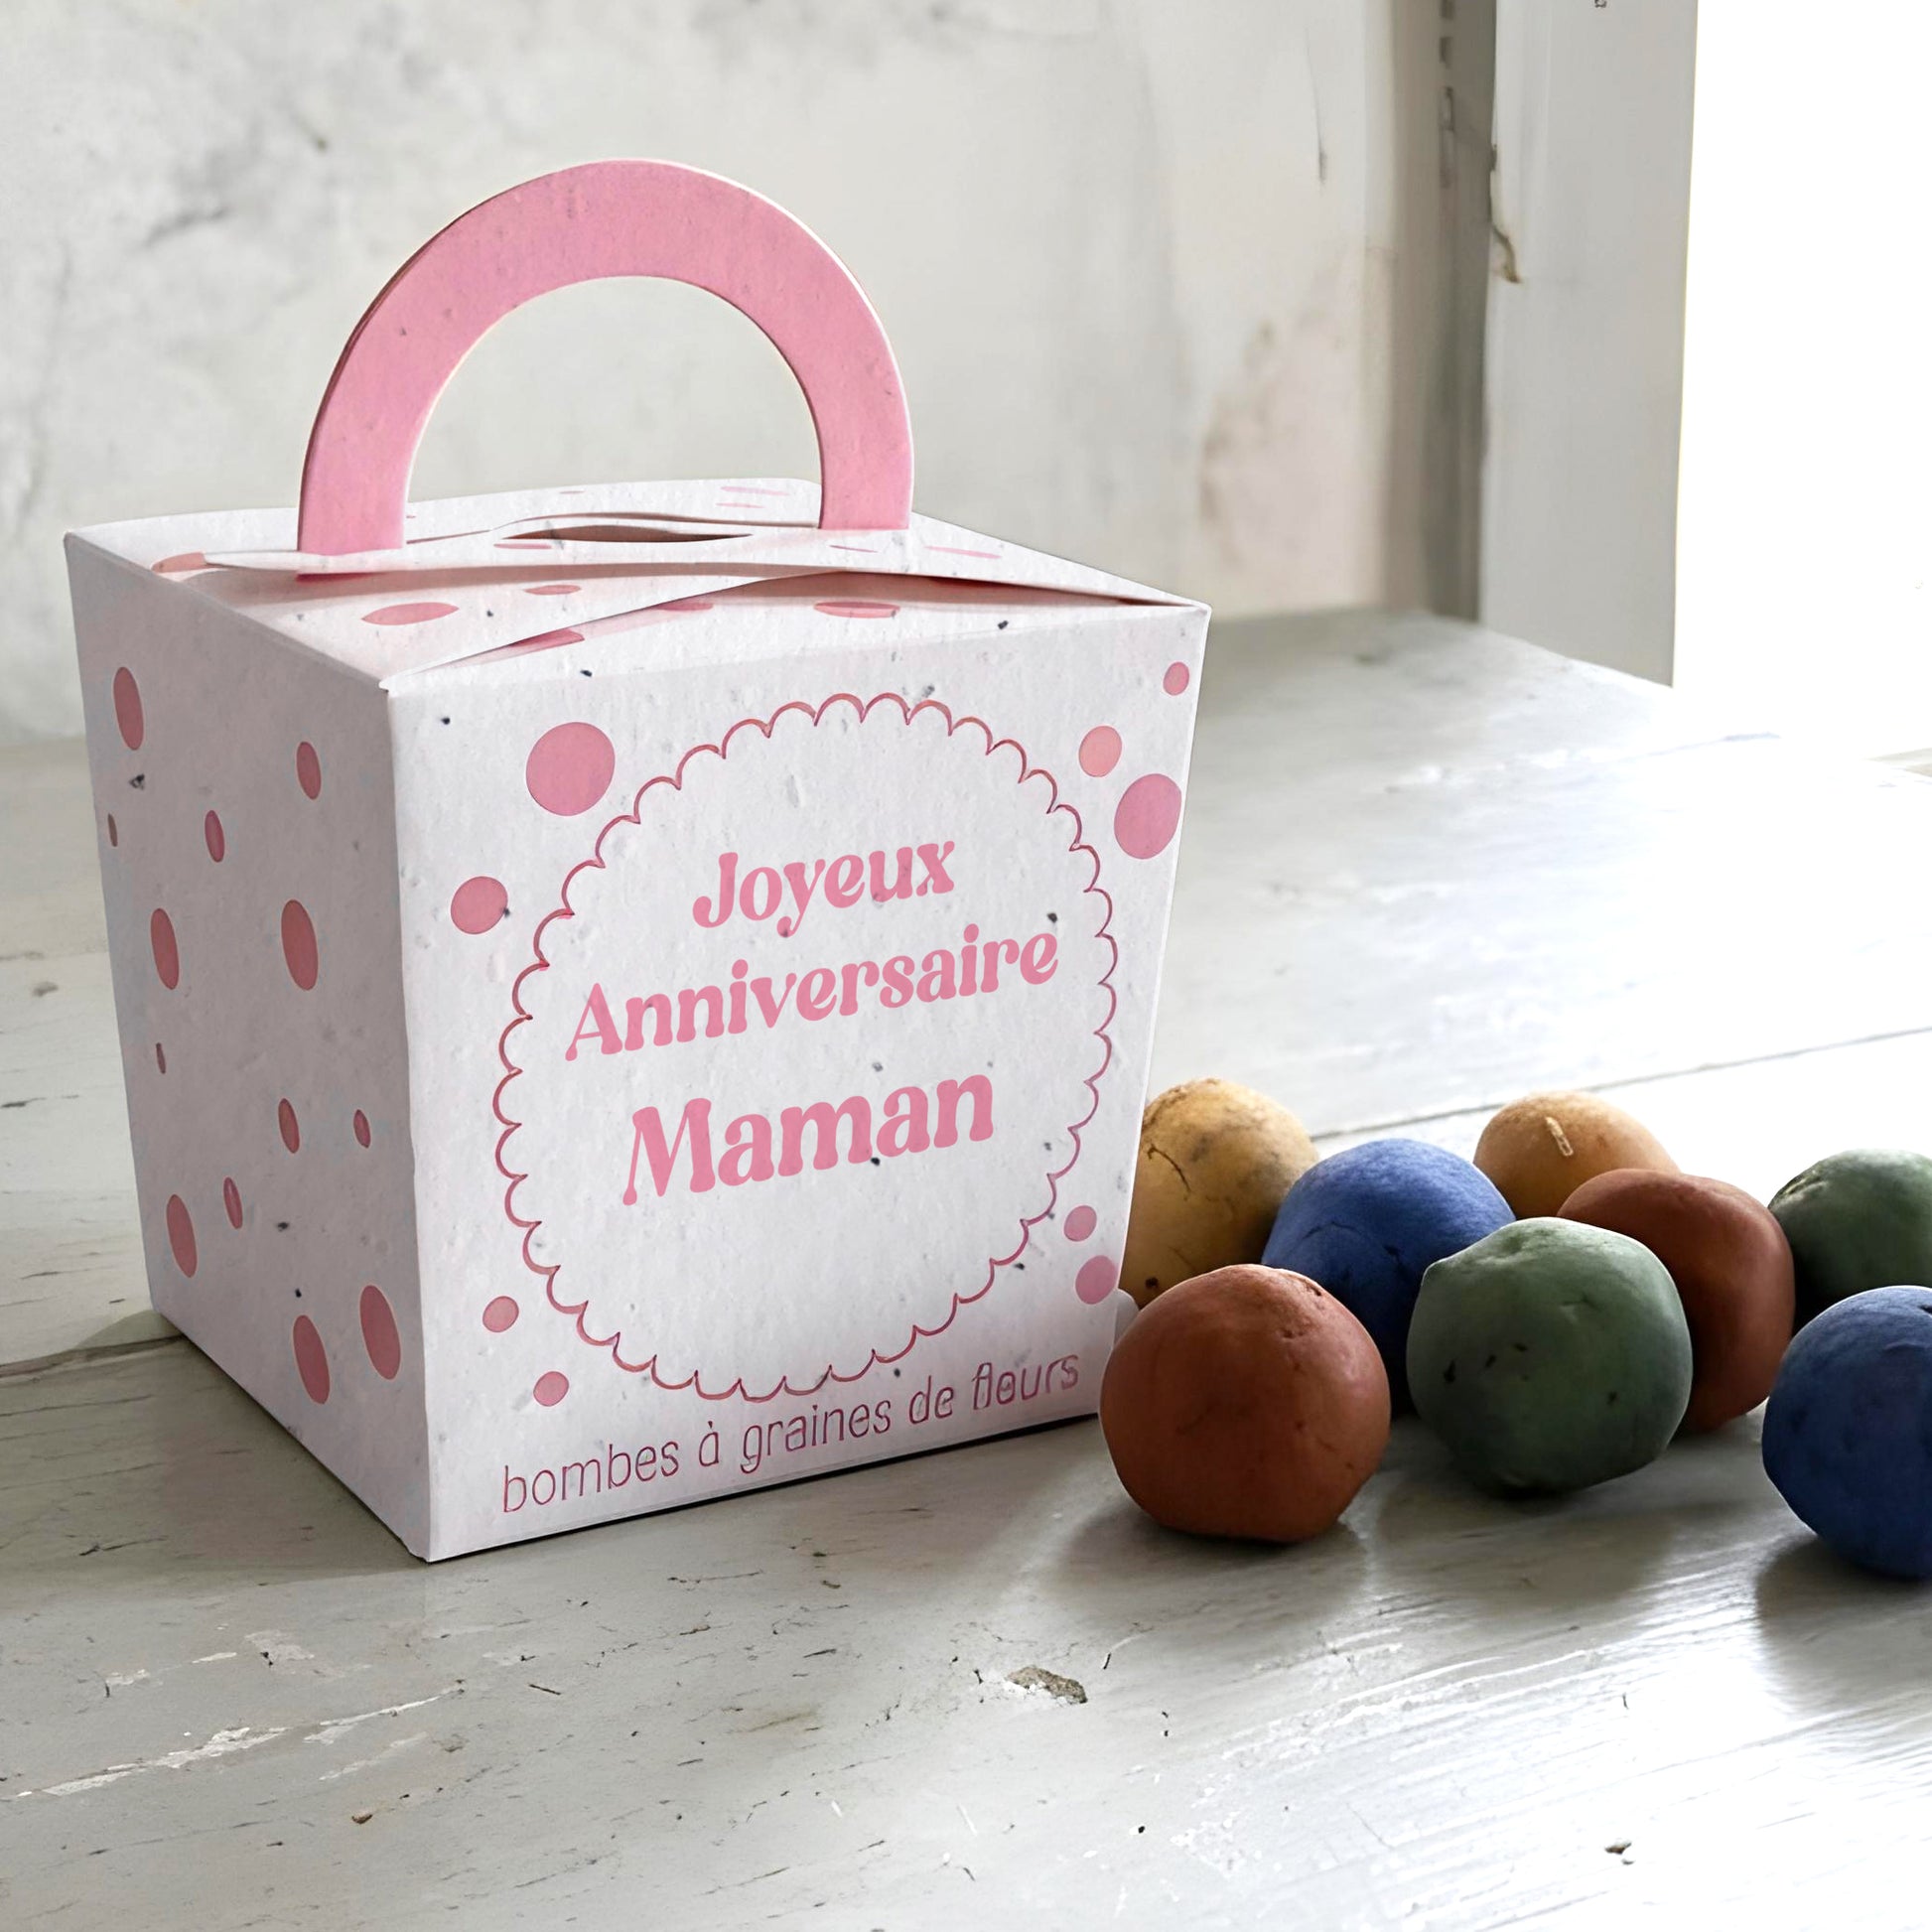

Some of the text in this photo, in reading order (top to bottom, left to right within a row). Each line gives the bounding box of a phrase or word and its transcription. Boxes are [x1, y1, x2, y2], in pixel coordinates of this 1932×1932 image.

[692, 841, 955, 937] Joyeux
[566, 923, 1059, 1061] Anniversaire
[623, 1075, 994, 1205] Maman
[503, 1441, 679, 1513] bombes
[698, 1421, 720, 1467] à
[740, 1404, 892, 1474] graines
[908, 1375, 955, 1425] de
